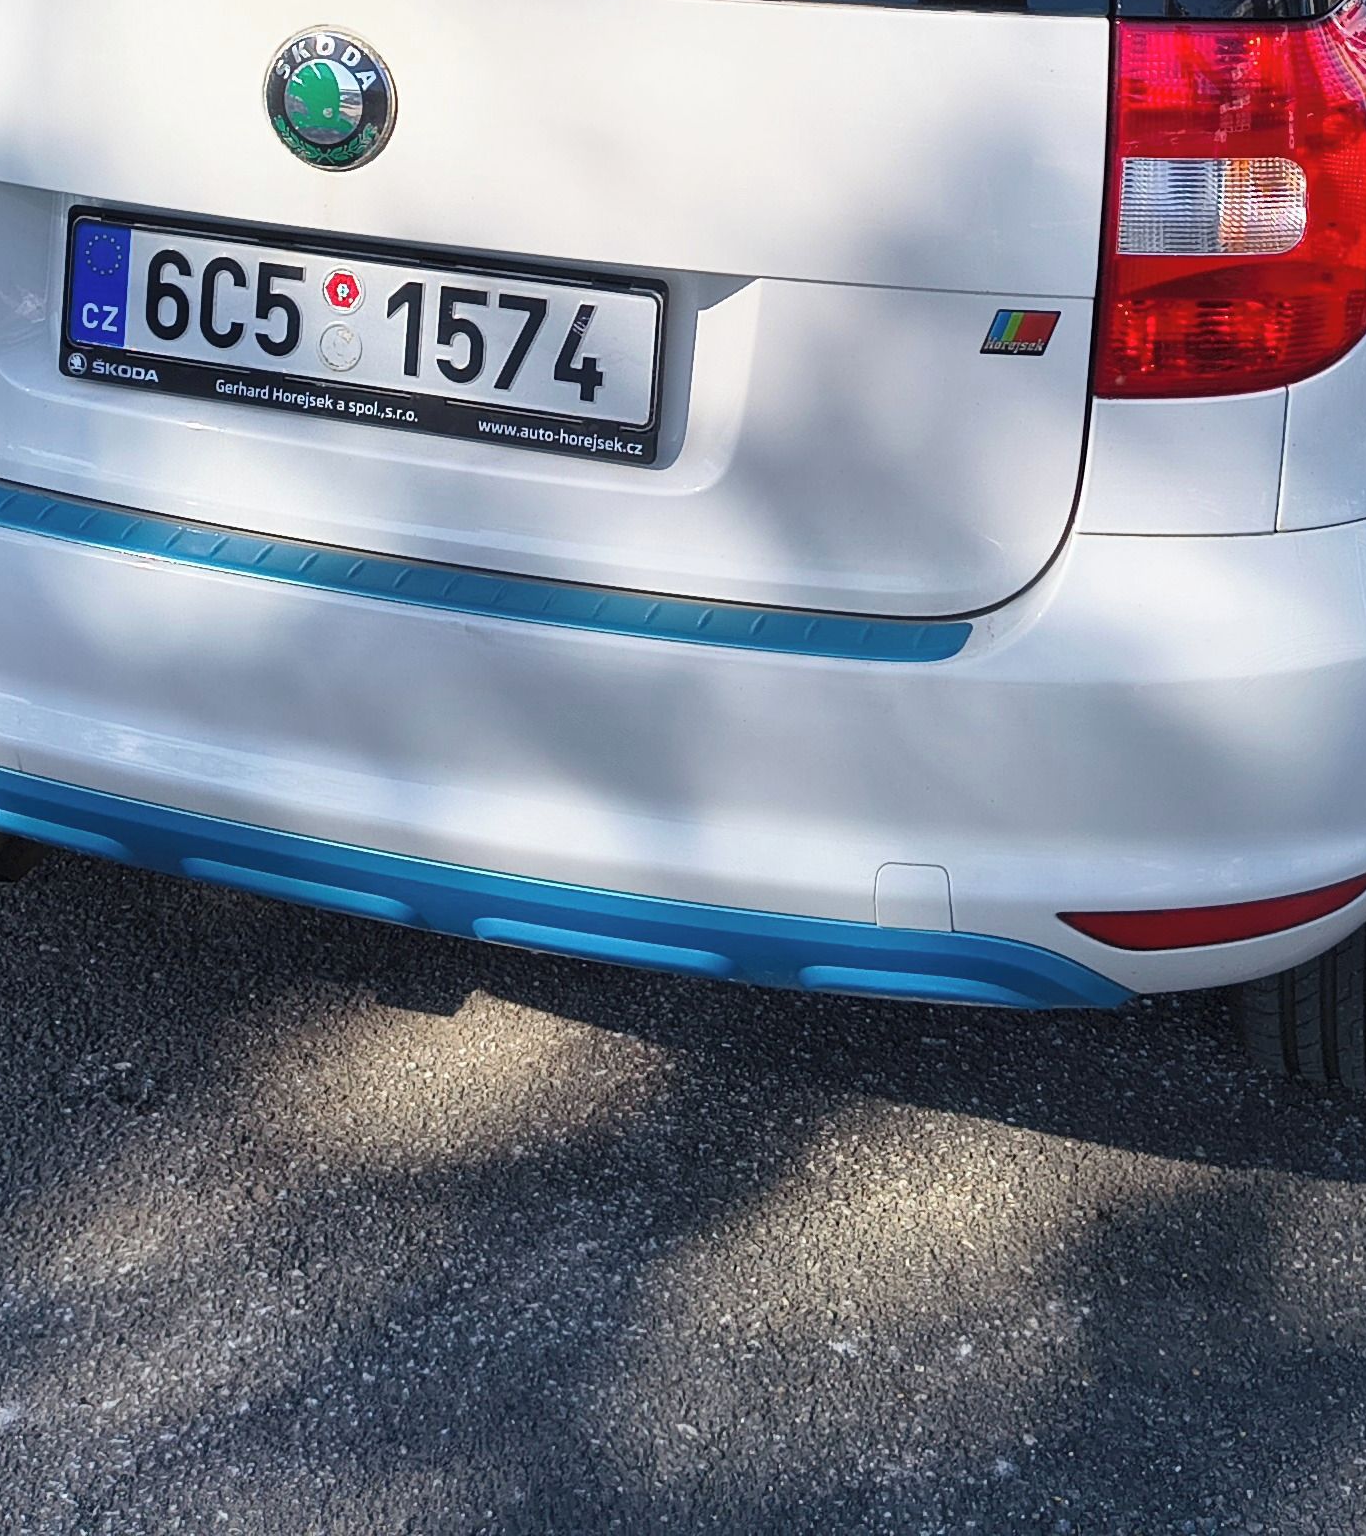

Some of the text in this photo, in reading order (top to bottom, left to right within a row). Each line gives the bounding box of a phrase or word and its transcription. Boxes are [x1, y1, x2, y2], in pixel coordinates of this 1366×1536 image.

[81, 249, 604, 402] CZ 6C5 1574
[91, 358, 159, 383] ŠKODA
[215, 378, 269, 400] Gerhard
[272, 387, 333, 409] Horejsek
[336, 399, 345, 411] a
[478, 420, 643, 455] www.auto-horejsek.cz
